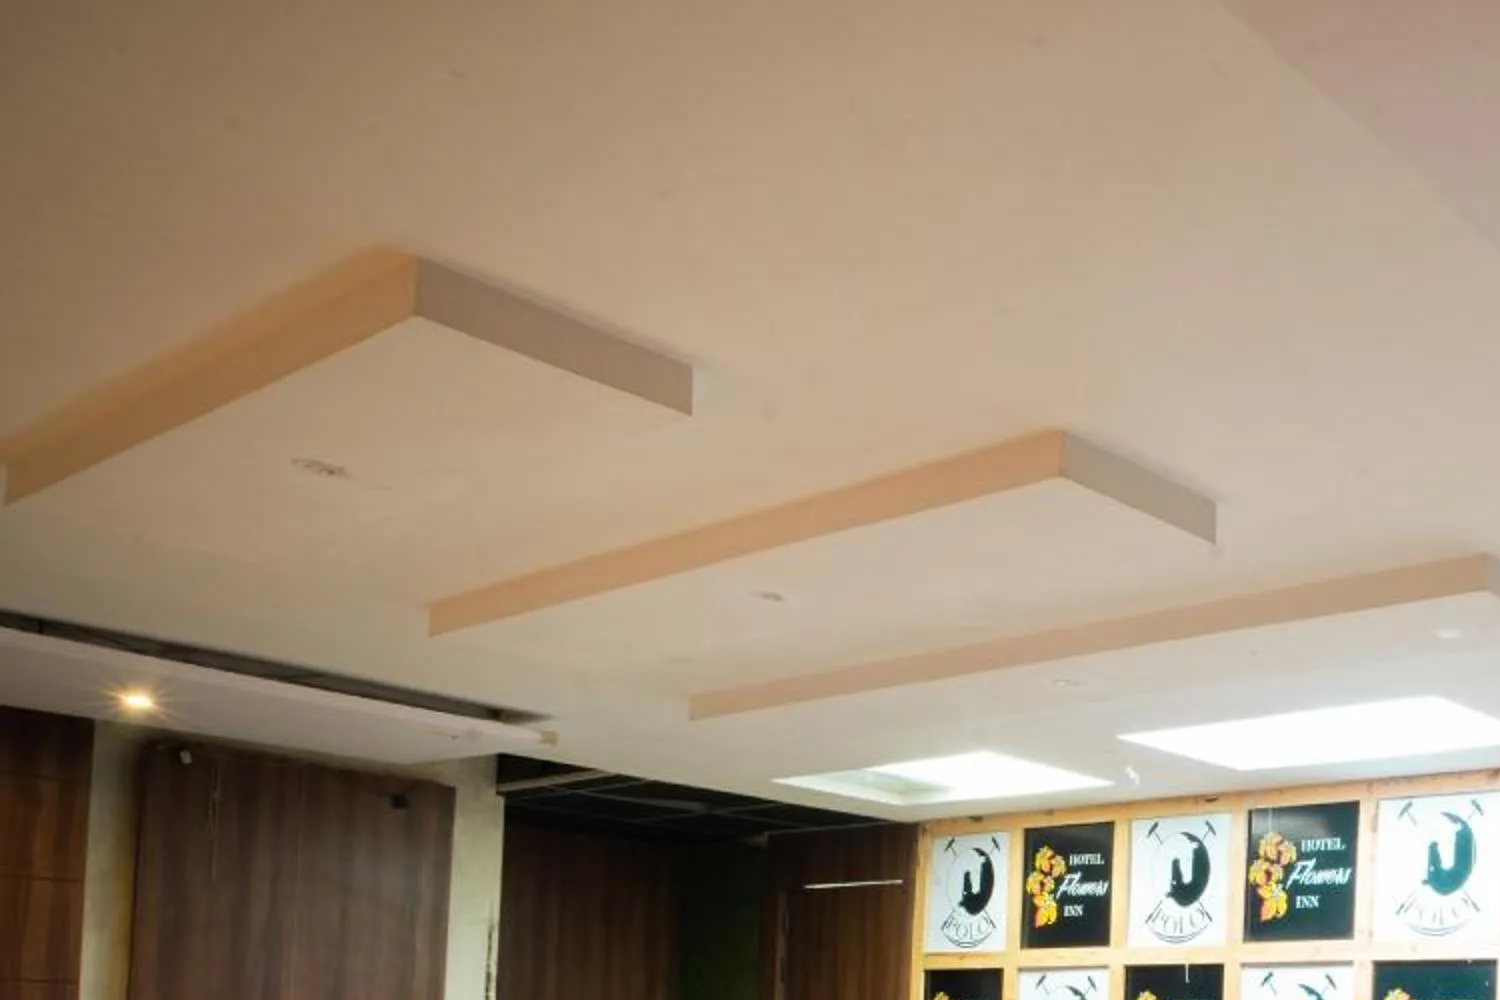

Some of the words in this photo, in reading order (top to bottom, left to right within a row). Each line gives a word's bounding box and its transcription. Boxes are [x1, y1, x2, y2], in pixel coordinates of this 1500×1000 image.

[1301, 837, 1346, 852] HOTEL
[1069, 852, 1105, 866] HOTEL
[1285, 857, 1353, 890] Flowers
[1055, 871, 1110, 900] Flowers
[1295, 895, 1320, 909] INN
[1063, 904, 1084, 917] INN
